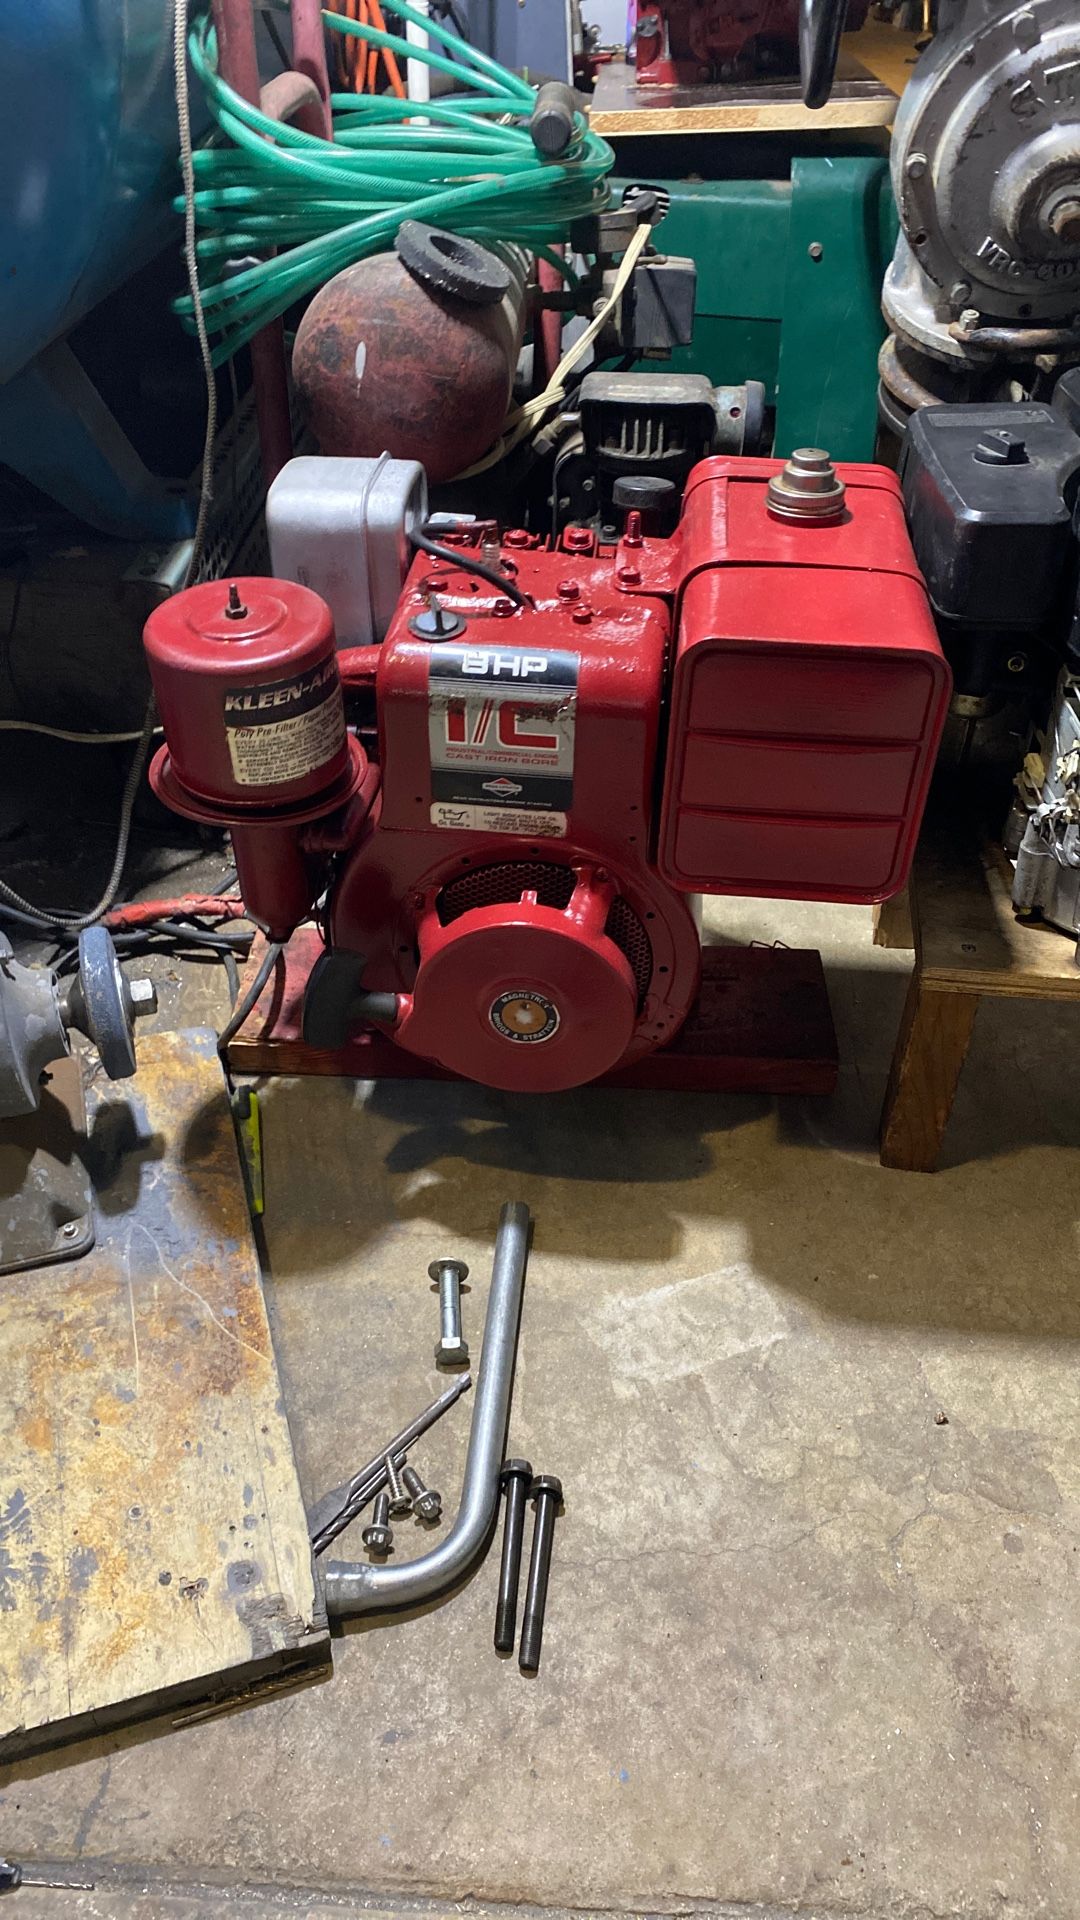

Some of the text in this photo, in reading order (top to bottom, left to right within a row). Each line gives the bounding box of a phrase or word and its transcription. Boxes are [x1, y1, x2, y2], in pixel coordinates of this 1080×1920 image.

[445, 752, 559, 766] CAST IRON BORE
[522, 1019, 555, 1041] STRATTON
